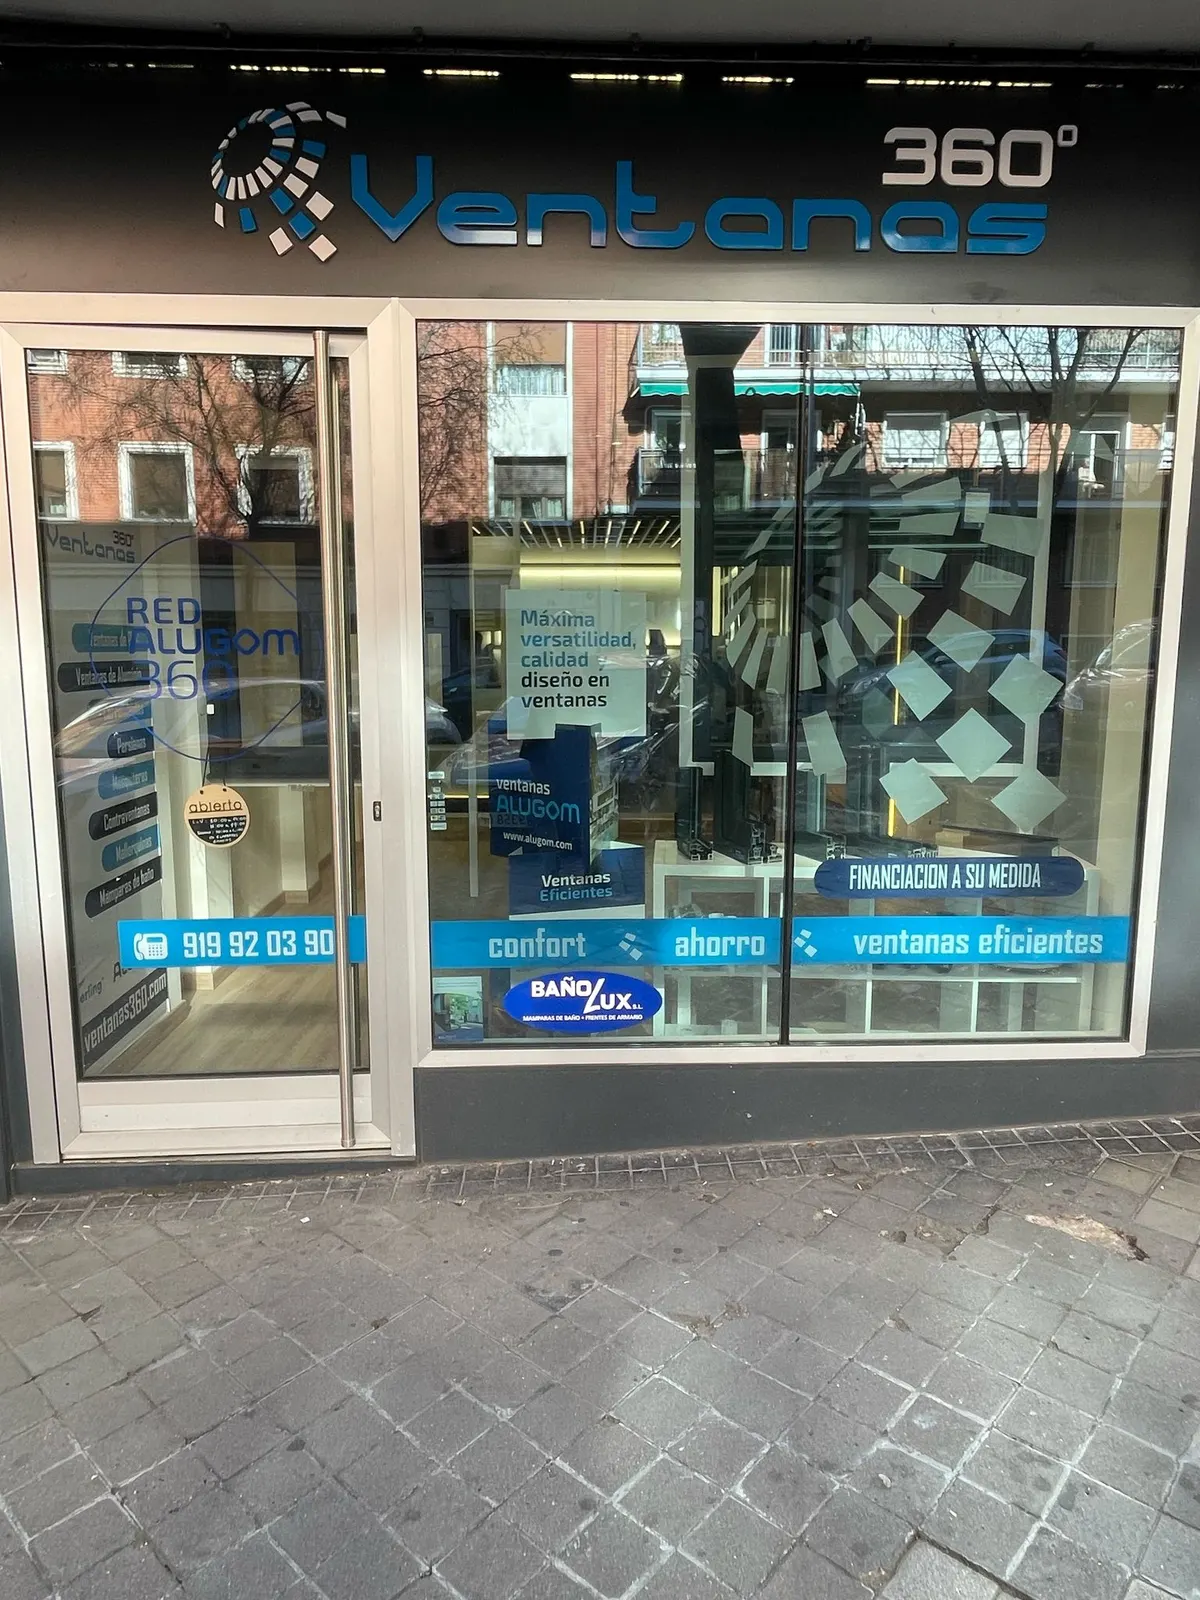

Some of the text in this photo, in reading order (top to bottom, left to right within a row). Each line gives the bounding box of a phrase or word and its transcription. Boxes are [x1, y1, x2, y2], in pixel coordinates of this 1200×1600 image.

[350, 153, 1049, 256] Ventanas
[46, 523, 135, 564] Ventanas
[126, 597, 201, 625] RED
[520, 609, 595, 628] Máxima
[128, 627, 301, 656] ALUGOM
[520, 631, 637, 650] versatilidad,
[520, 651, 589, 668] calidad
[134, 659, 236, 701] 360
[521, 671, 610, 688] diseño en
[521, 693, 607, 708] ventanas
[496, 778, 551, 796] ventanas
[103, 802, 151, 831] Contraventanas
[189, 799, 243, 813] abierto
[496, 795, 581, 825] ALUGOM
[503, 830, 573, 851] www.alugom.com
[99, 881, 132, 908] Mamparas
[132, 873, 141, 889] de
[541, 873, 611, 888] Ventanas
[849, 863, 1042, 890] FINANCIACION A SU MEDIDA
[539, 886, 613, 902] Eficientes
[182, 929, 335, 959] 919 92 03 90
[488, 927, 586, 959] confort
[675, 926, 766, 957] ahorro
[853, 923, 1104, 956] ventanas eficientes
[83, 973, 167, 1052] ventanas360.com
[564, 1013, 581, 1021] BAÑO
